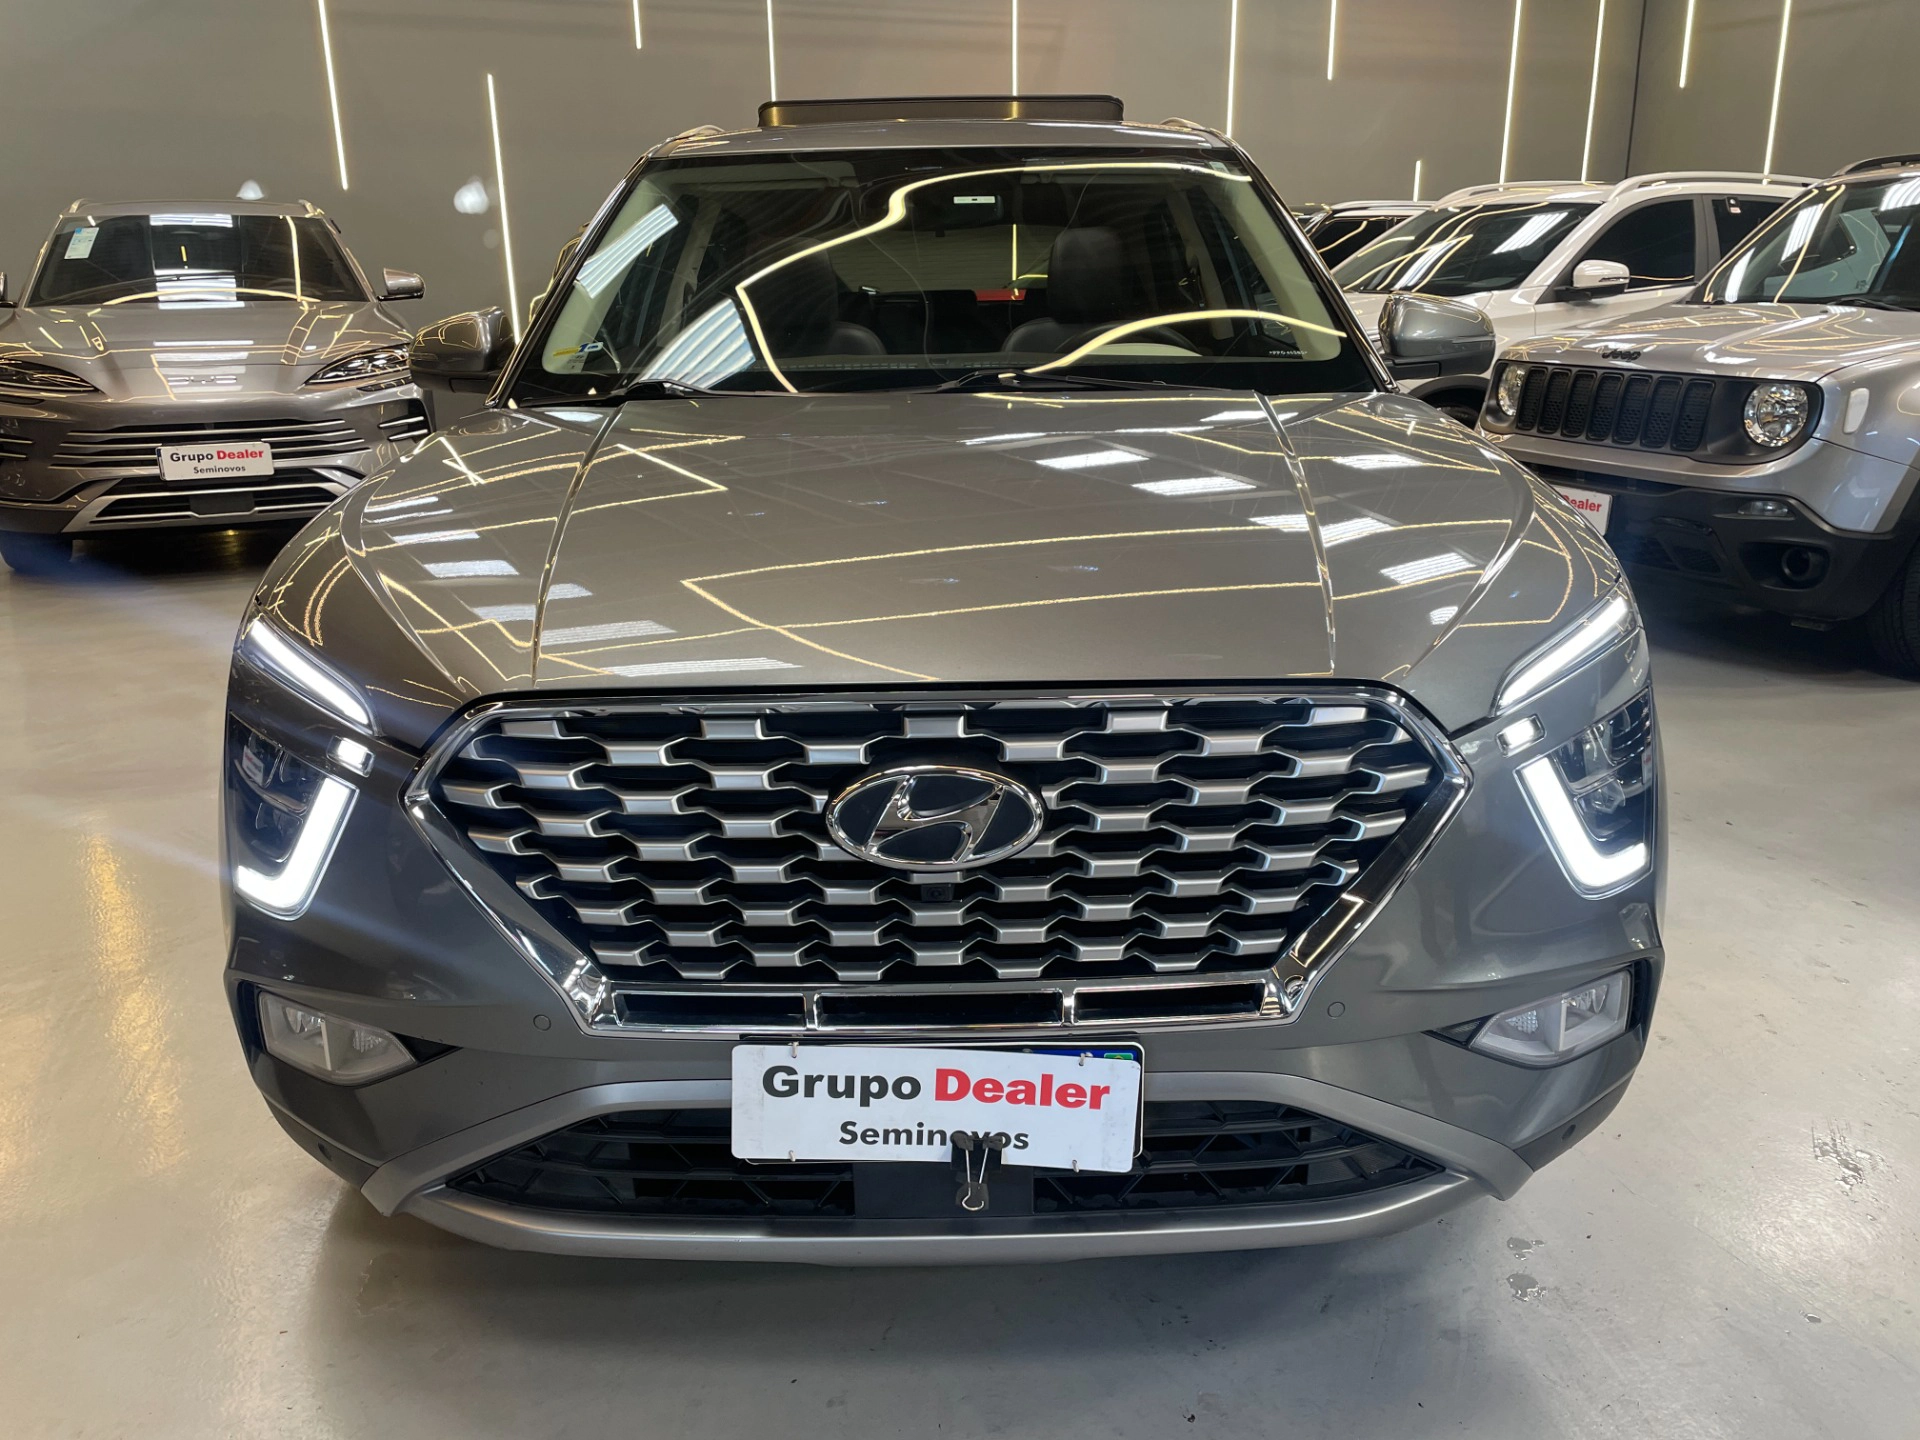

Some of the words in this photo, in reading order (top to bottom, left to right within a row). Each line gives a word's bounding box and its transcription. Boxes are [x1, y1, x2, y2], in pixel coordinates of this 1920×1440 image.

[1601, 348, 1641, 362] Jeep
[170, 452, 214, 463] Grupo
[216, 449, 264, 460] Dealer
[193, 465, 246, 474] Seminovos
[1562, 494, 1602, 512] ealer
[762, 1065, 921, 1107] Grupo
[935, 1068, 1111, 1110] Dealer
